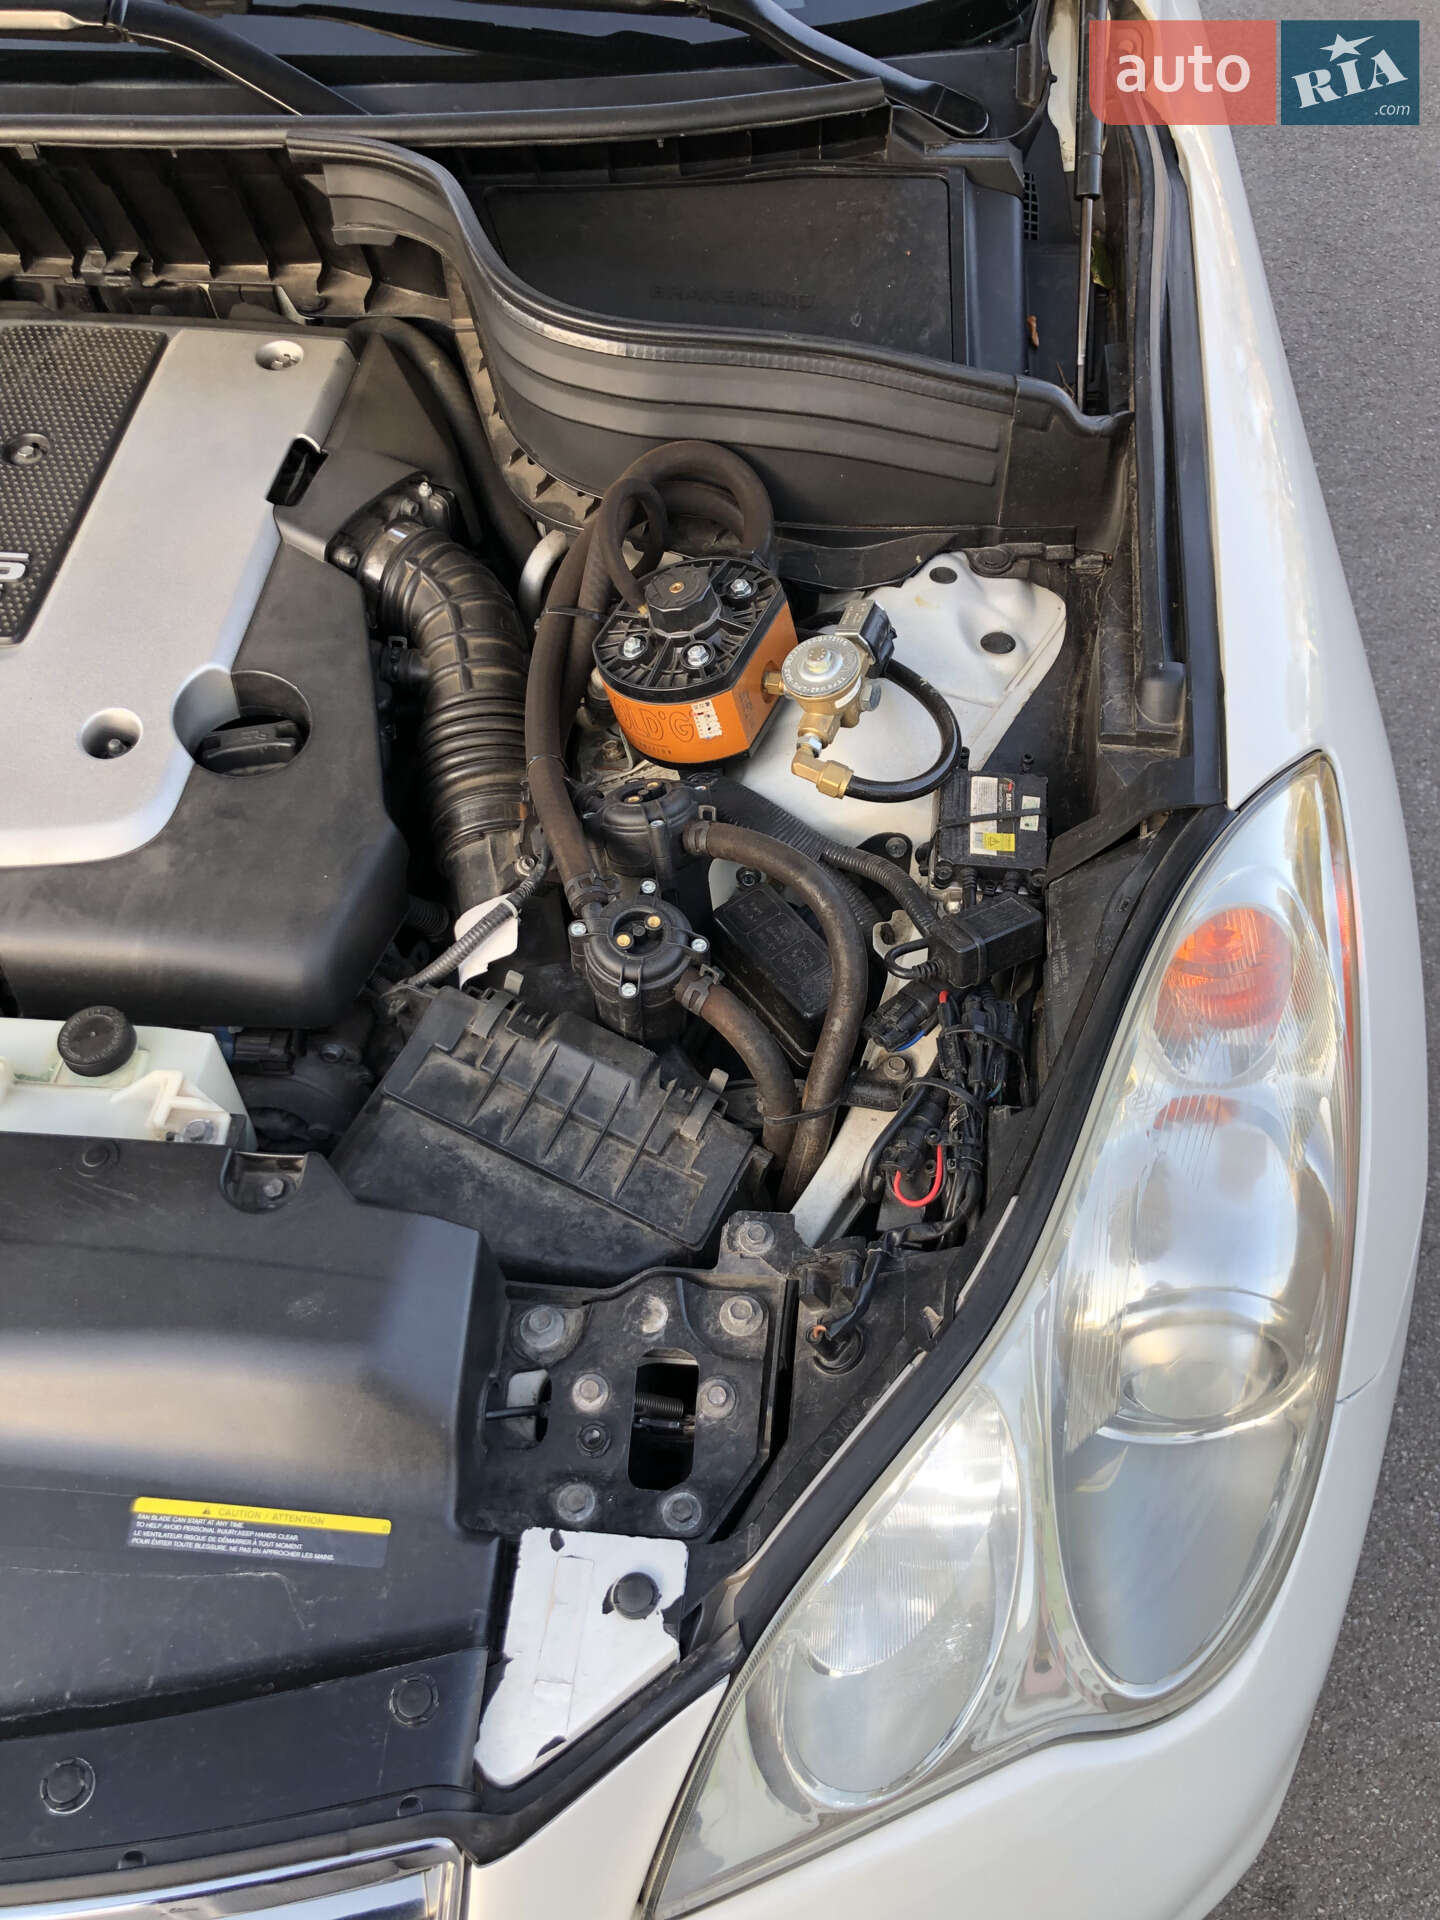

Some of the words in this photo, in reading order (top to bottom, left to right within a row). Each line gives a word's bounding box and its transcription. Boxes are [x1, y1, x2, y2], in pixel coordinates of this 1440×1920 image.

[151, 1514, 171, 1522] BLADE
[172, 1515, 186, 1523] CAN
[218, 1507, 261, 1519] CAUTION
[271, 1512, 325, 1525] ATTENTION
[162, 1523, 182, 1531] AVOID
[183, 1525, 215, 1533] PERSONAL
[142, 1531, 183, 1539] VENTILATEUR
[184, 1534, 207, 1542] RISQUE
[131, 1537, 150, 1545] POUR
[174, 1541, 193, 1549] TOUTE
[262, 1548, 301, 1558] APPROCHER
